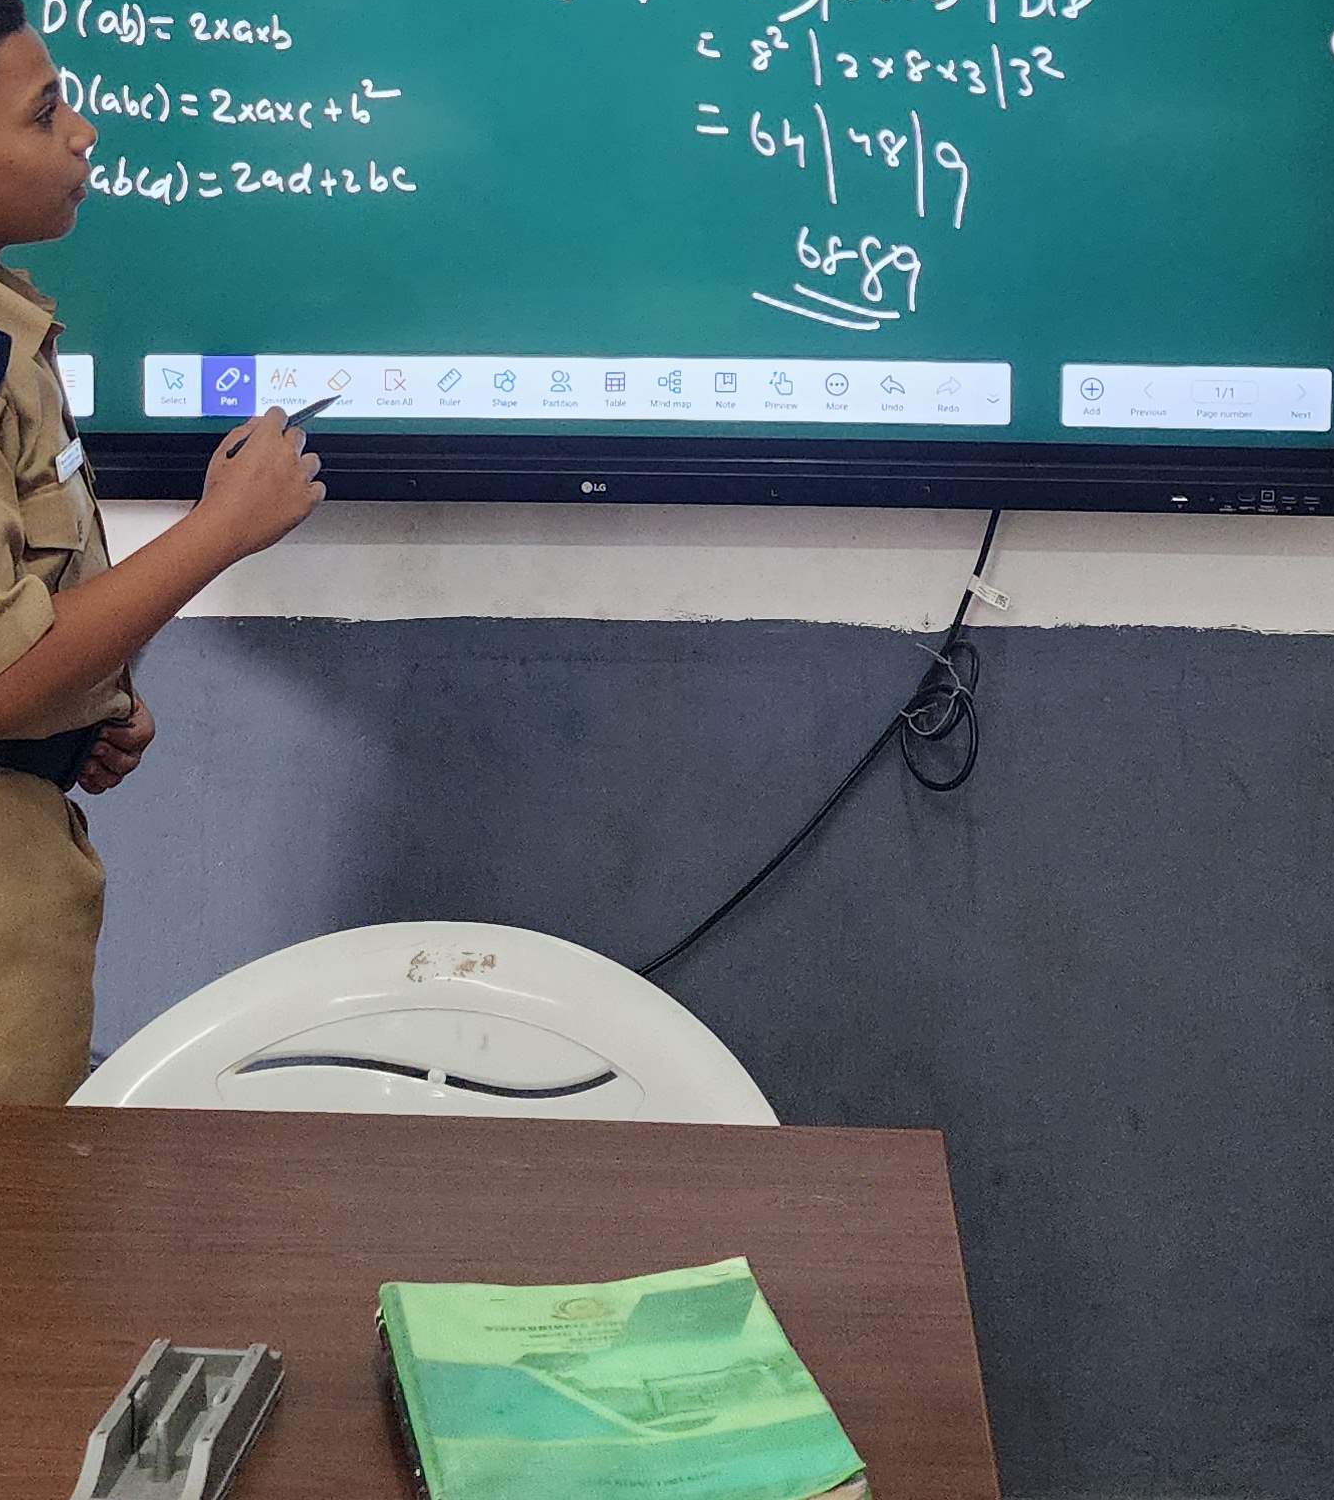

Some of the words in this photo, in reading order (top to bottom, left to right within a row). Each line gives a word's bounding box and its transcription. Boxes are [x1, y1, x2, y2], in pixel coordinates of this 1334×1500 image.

[795, 226, 922, 312] 6889
[1214, 386, 1235, 399] 1/1
[160, 396, 187, 406] Select
[220, 396, 238, 406] Pen
[376, 398, 400, 406] Clean
[401, 398, 413, 406] All
[439, 398, 461, 407] Ruler
[492, 398, 518, 408] Shape
[605, 399, 627, 407] Table
[650, 400, 671, 408] Mind
[673, 401, 692, 410] map
[715, 400, 736, 409] Note
[764, 401, 798, 410] Preview
[826, 402, 849, 411] More
[881, 403, 904, 412] Undo
[937, 404, 960, 413] Redo
[1083, 407, 1101, 416] Add
[1130, 407, 1167, 417] Previous
[1196, 409, 1218, 419] Page
[1220, 410, 1253, 419] number
[1291, 410, 1312, 419] Next
